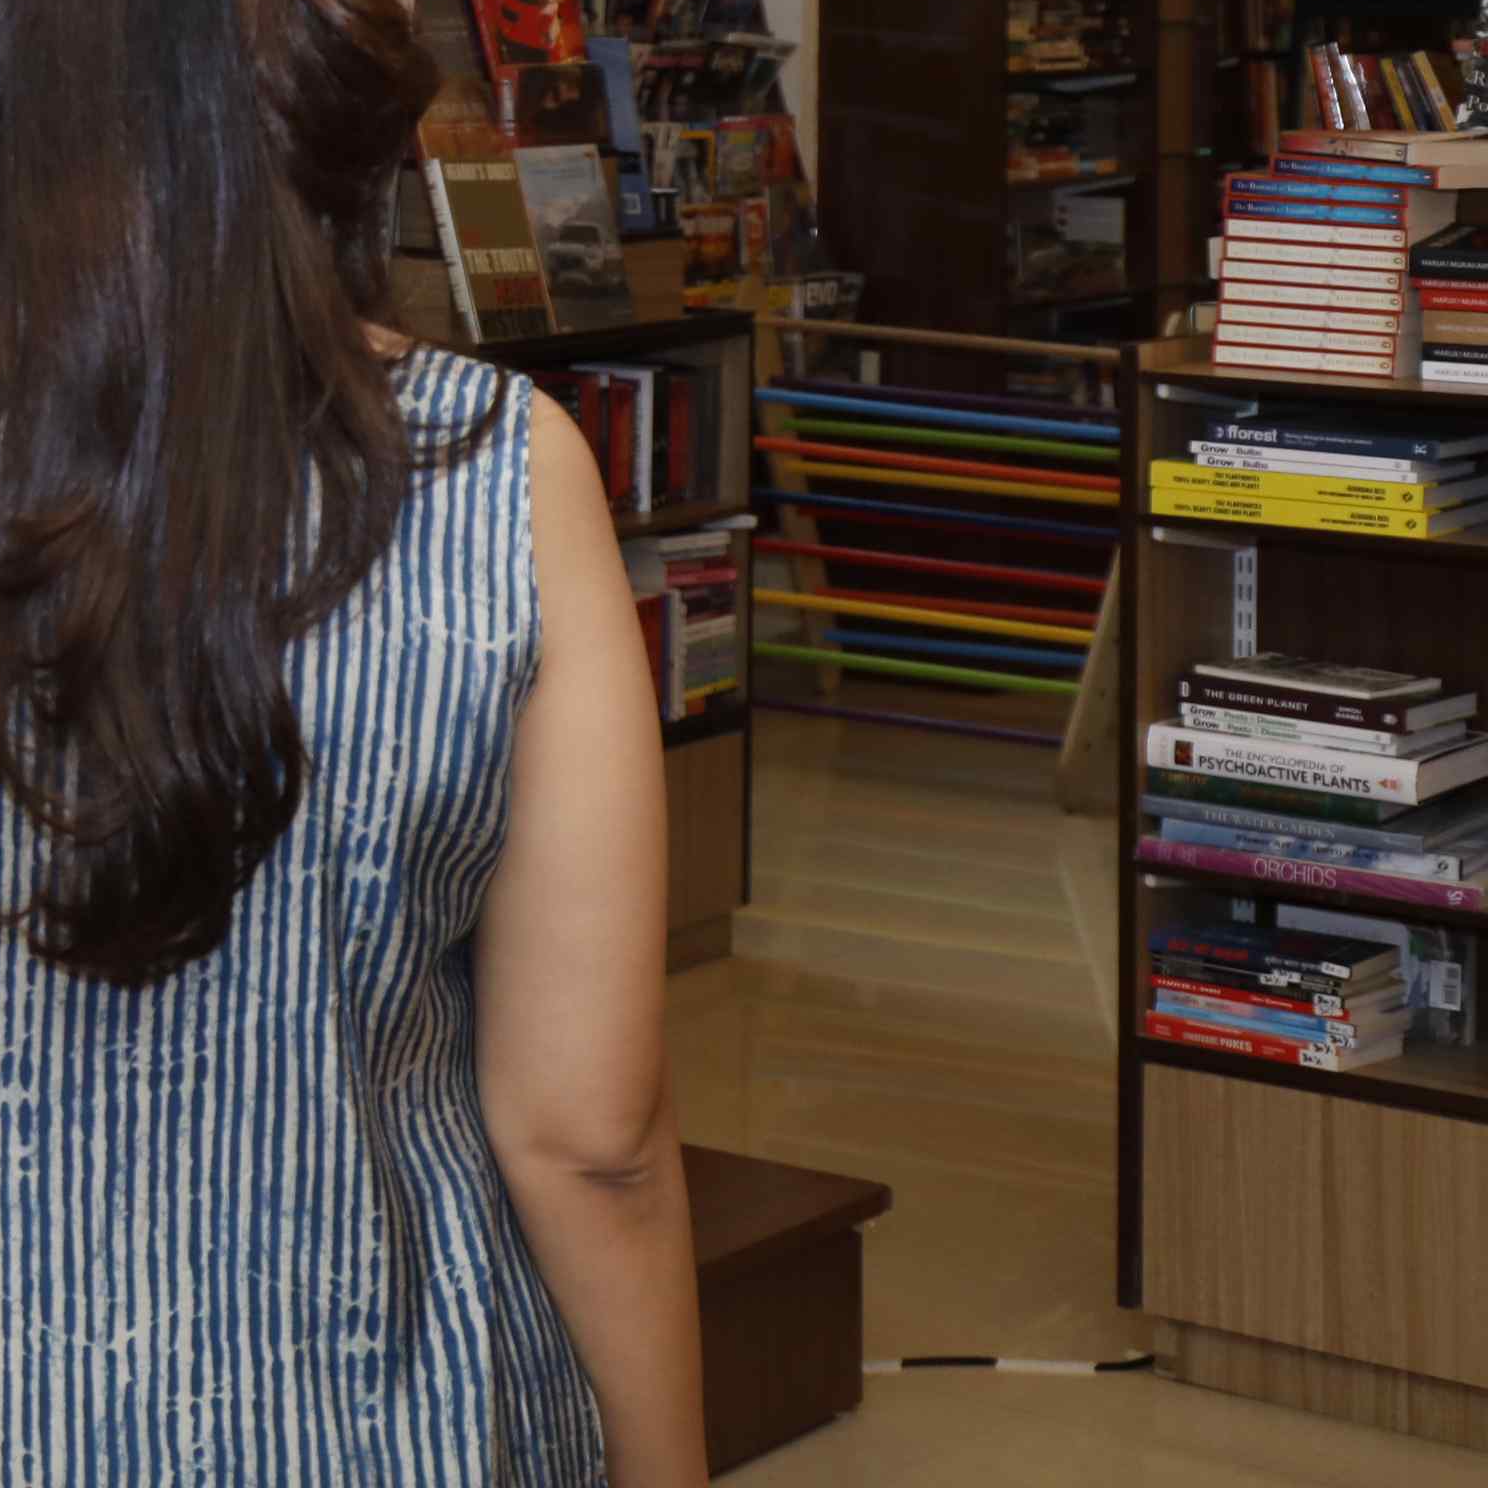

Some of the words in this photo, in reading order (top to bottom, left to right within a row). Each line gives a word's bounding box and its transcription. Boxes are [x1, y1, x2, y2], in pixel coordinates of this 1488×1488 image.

[1227, 424, 1279, 444] fforest
[1203, 687, 1225, 701] THE
[1227, 690, 1265, 706] GREEN
[1266, 697, 1310, 714] PLANET
[1198, 754, 1310, 786] PSYCHOACTIVE
[1312, 771, 1371, 794] PLANTS
[1224, 746, 1244, 759] THE
[1246, 749, 1328, 772] ENCYCLOPEDIA
[1329, 762, 1346, 775] OF
[1254, 857, 1338, 890] ORCHIDS
